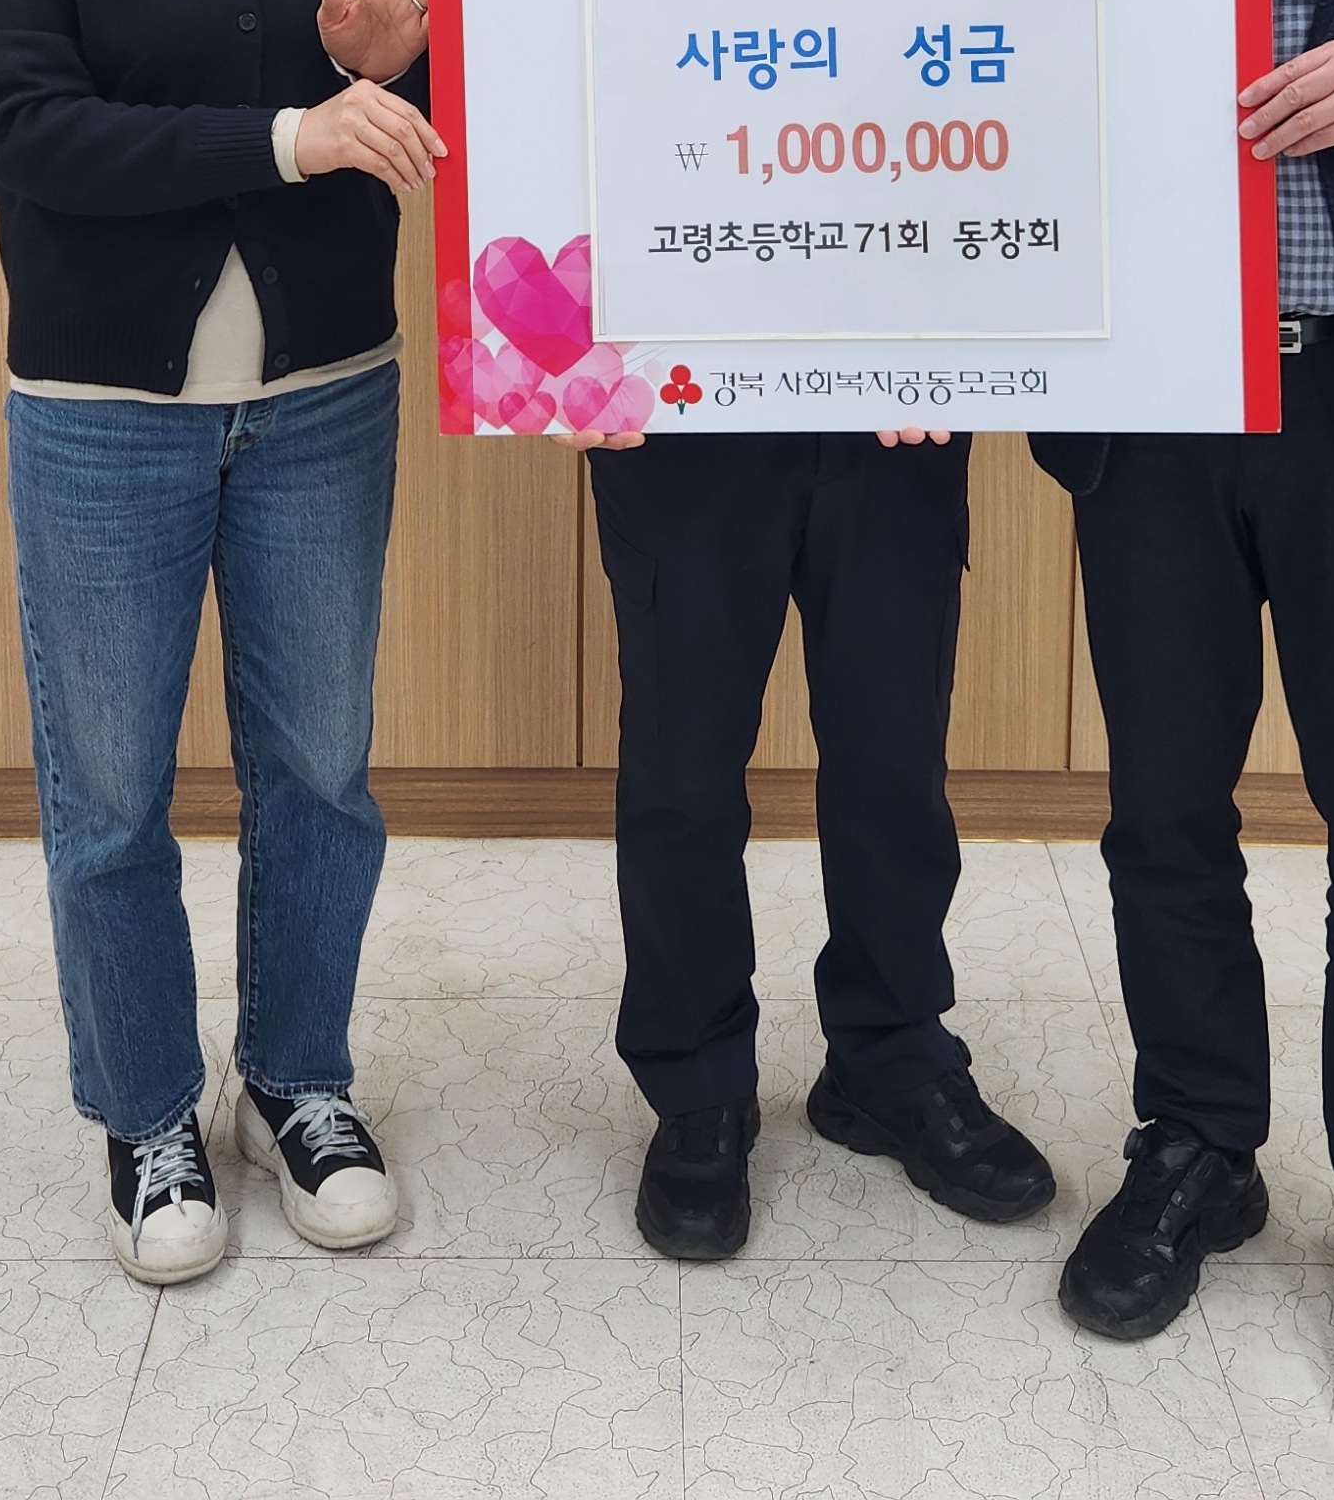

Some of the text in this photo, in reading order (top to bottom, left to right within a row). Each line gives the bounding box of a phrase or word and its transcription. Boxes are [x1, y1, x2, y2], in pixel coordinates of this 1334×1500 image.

[675, 23, 1016, 91] 사랑의 성금
[726, 119, 1009, 186] 1,000,000
[952, 217, 1060, 261] 동창회
[709, 367, 1048, 407] 경북 사회복지공동모금회
